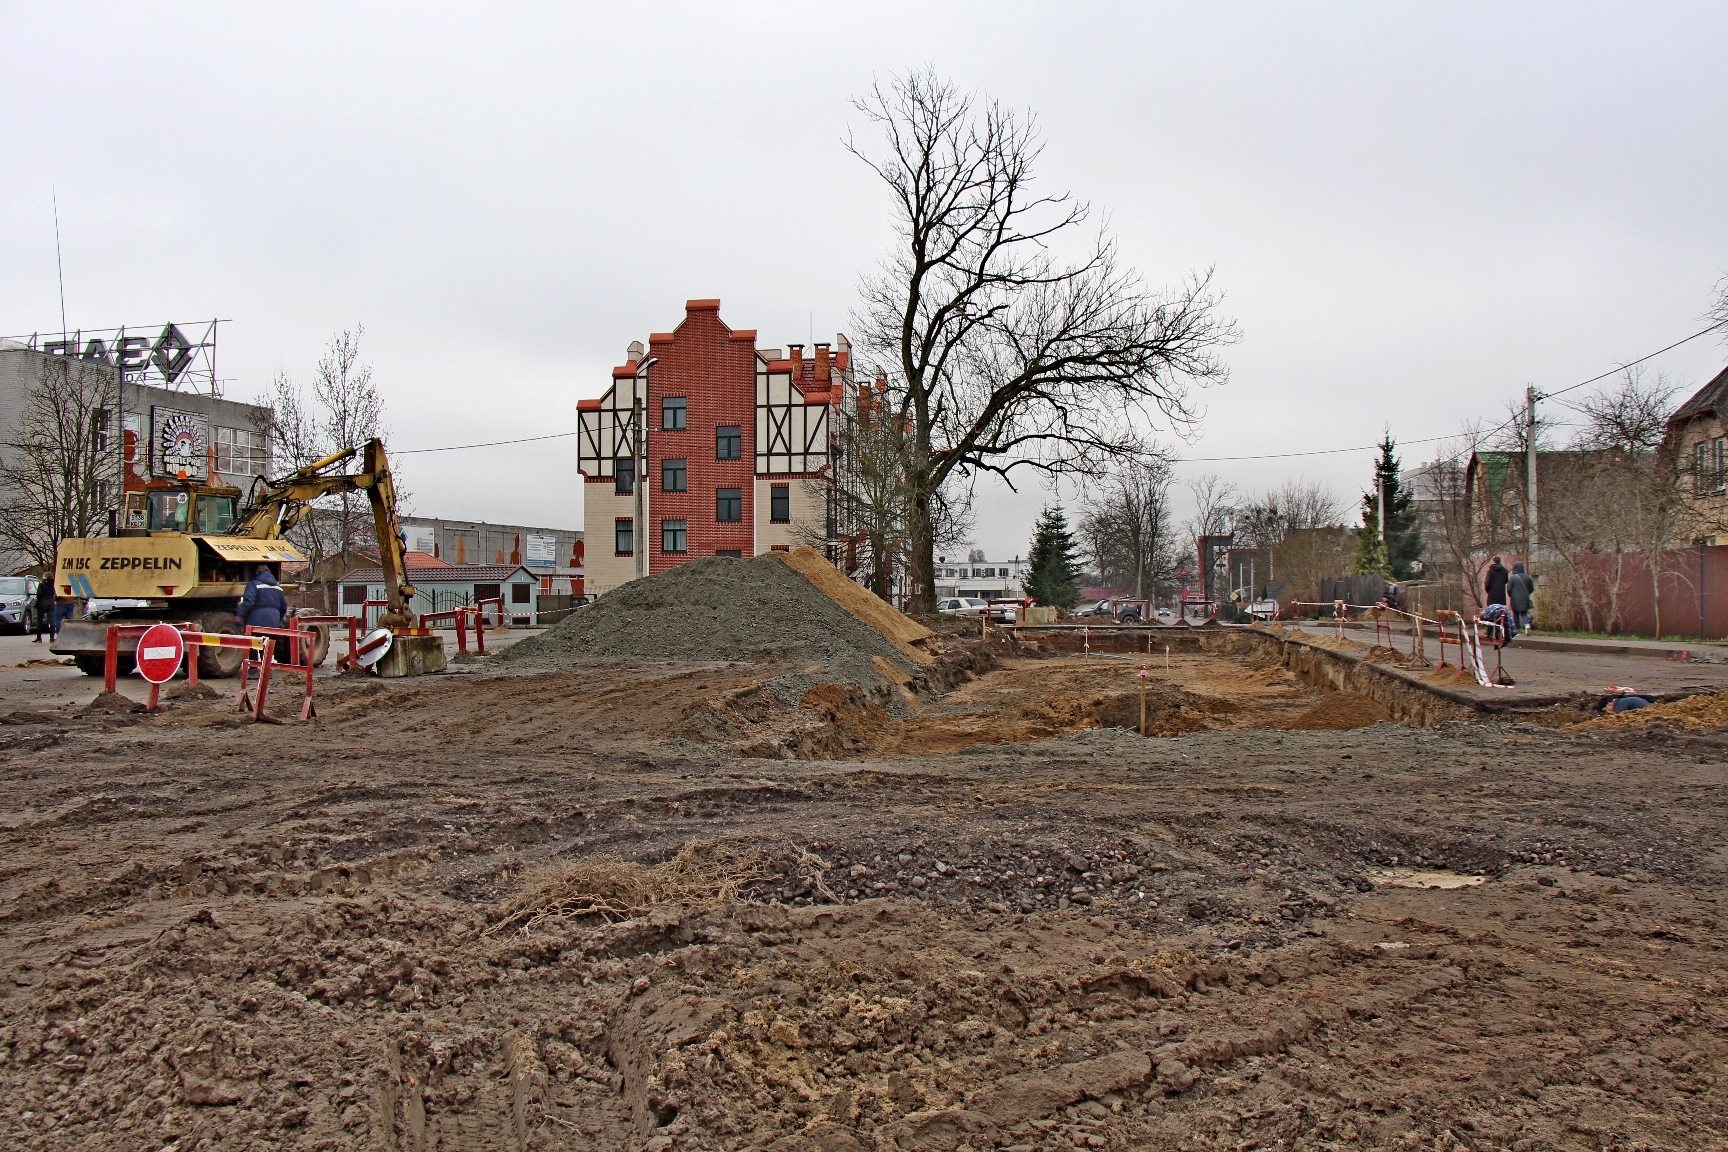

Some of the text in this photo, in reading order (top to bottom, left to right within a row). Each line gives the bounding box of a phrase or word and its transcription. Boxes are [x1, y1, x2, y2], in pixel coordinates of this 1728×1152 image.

[214, 544, 260, 552] ZEPPELIN
[61, 557, 182, 570] ZM 15C ZEPPELIN
